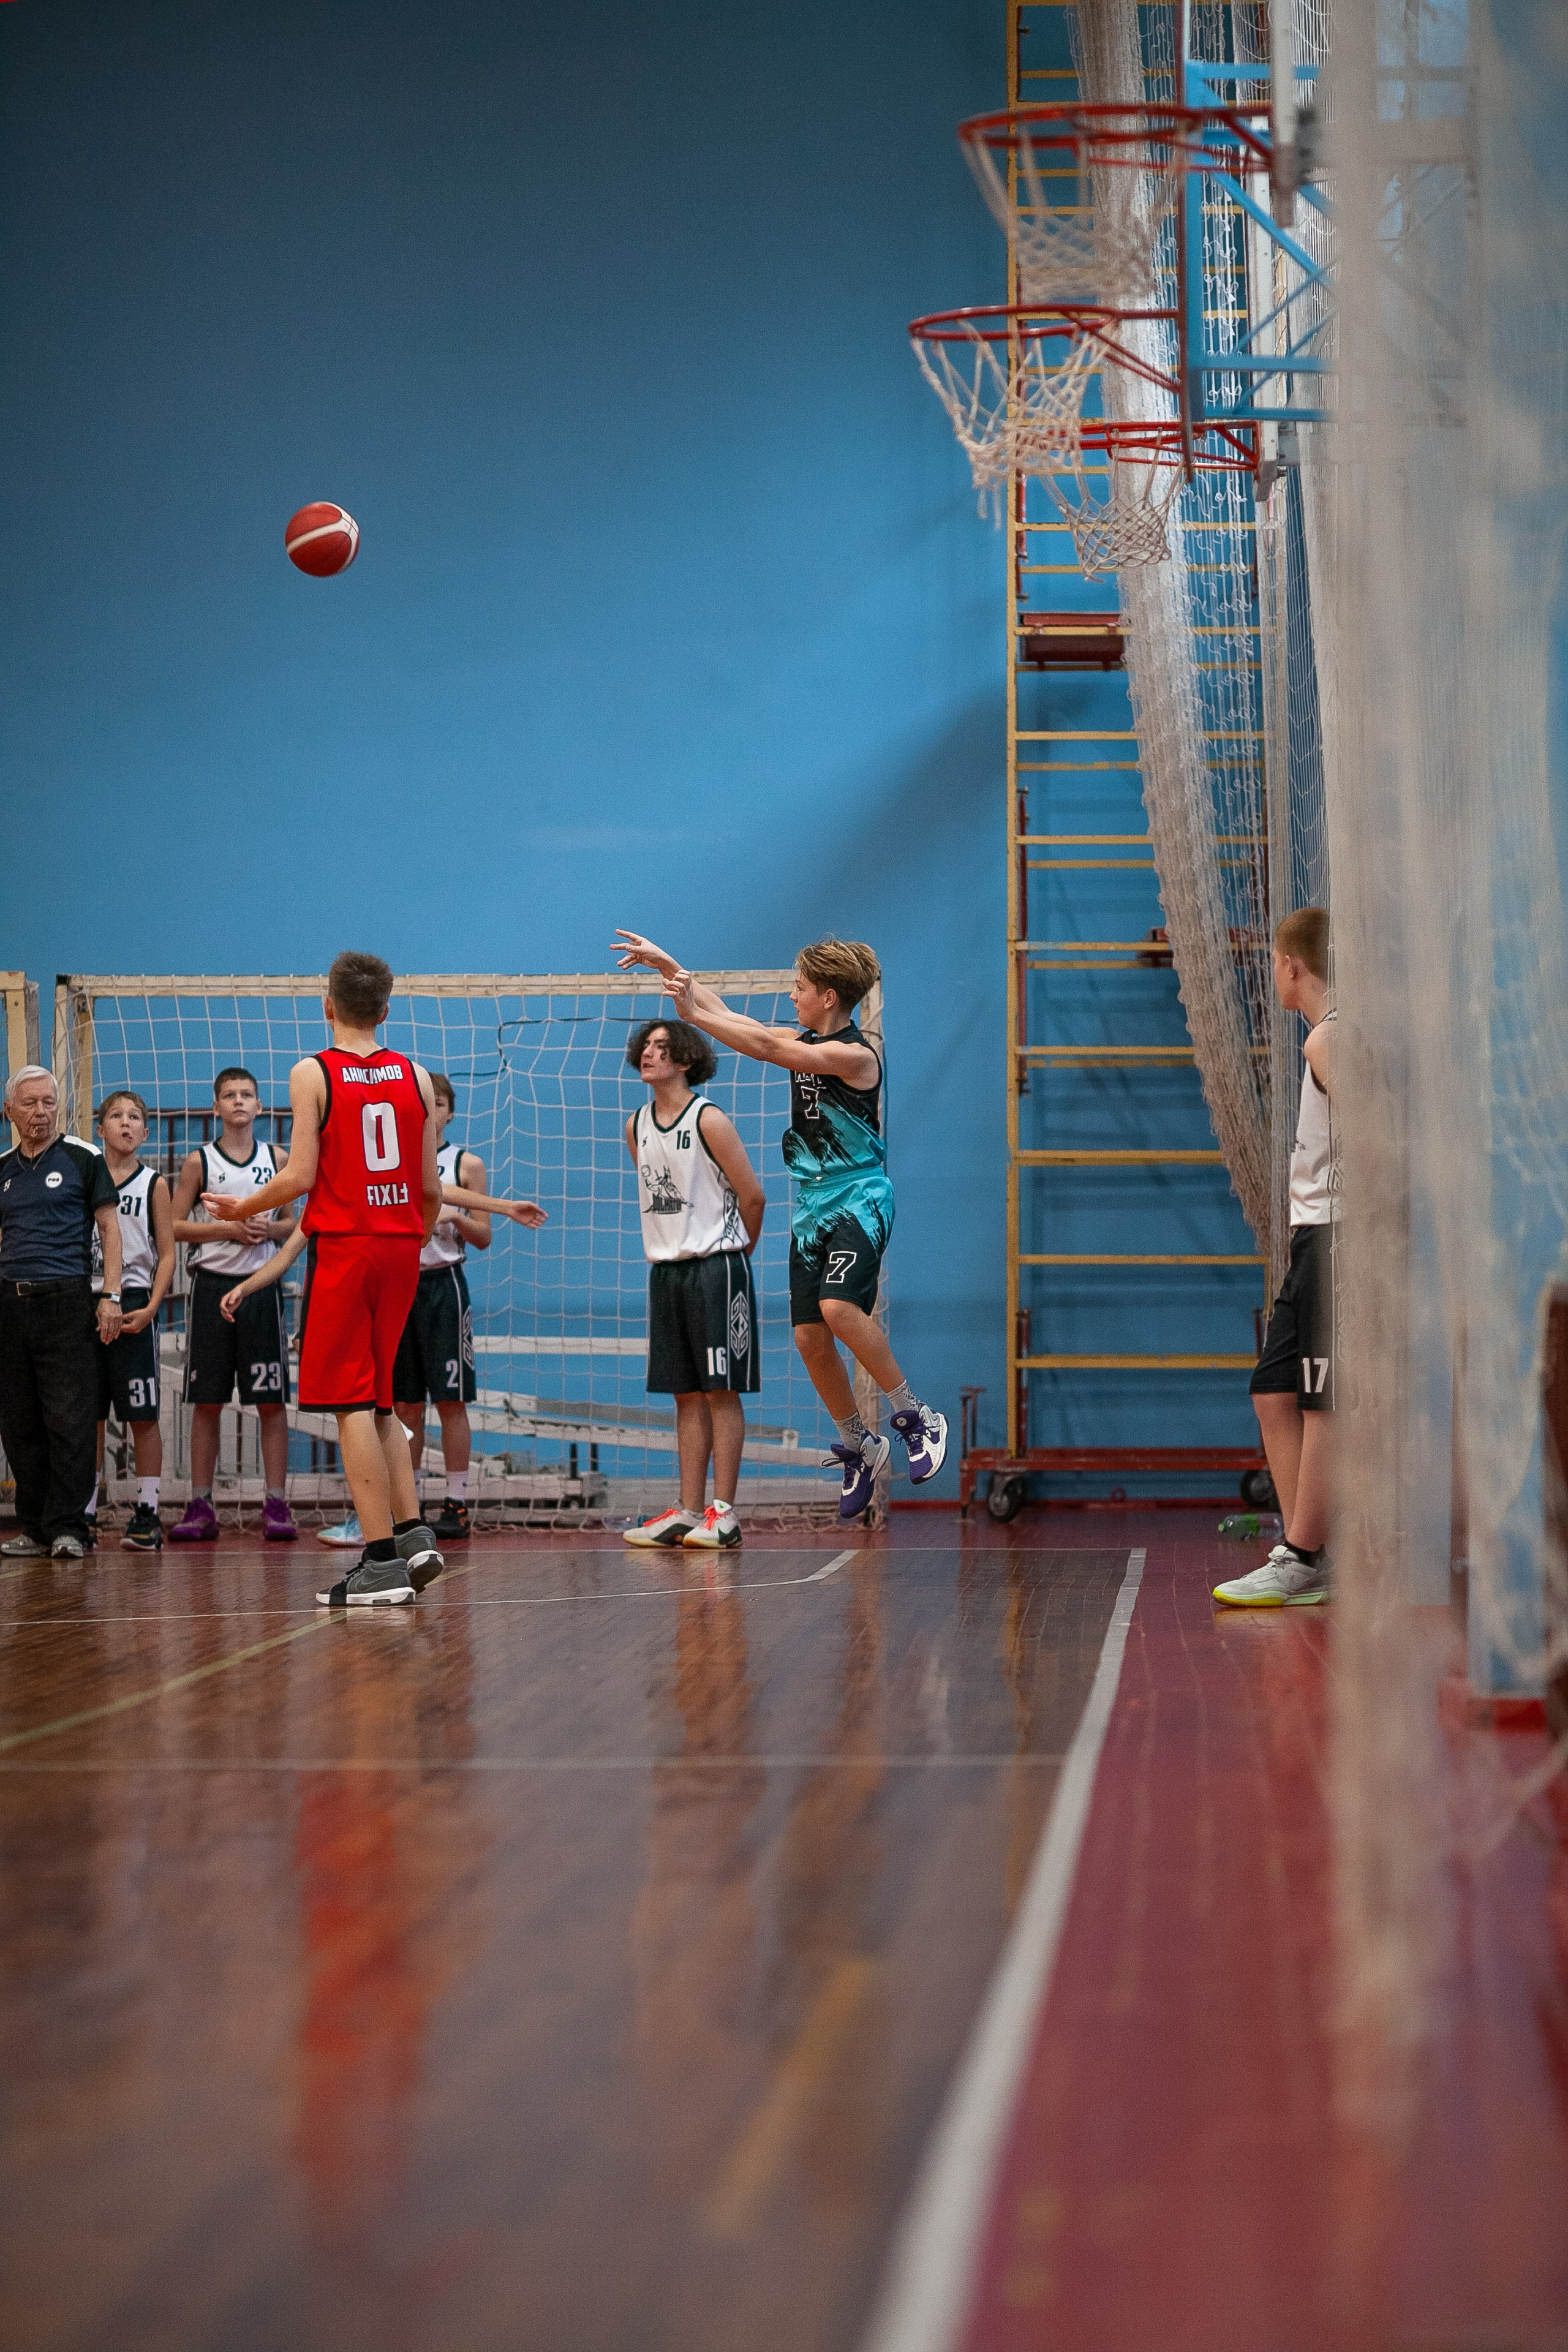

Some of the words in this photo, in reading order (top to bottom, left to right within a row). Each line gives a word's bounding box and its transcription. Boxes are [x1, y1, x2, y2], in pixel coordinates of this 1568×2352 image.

[342, 1065, 404, 1084] АНИСИМОВ
[801, 1085, 820, 1120] 7
[362, 1102, 400, 1171] 0
[676, 1130, 691, 1150] 16
[252, 1166, 272, 1185] 23
[121, 1195, 142, 1217] 31
[826, 1251, 857, 1283] 7
[446, 1360, 459, 1388] 2
[707, 1347, 727, 1376] 16
[1302, 1357, 1329, 1393] 17
[251, 1362, 282, 1391] 23
[128, 1378, 157, 1407] 31
